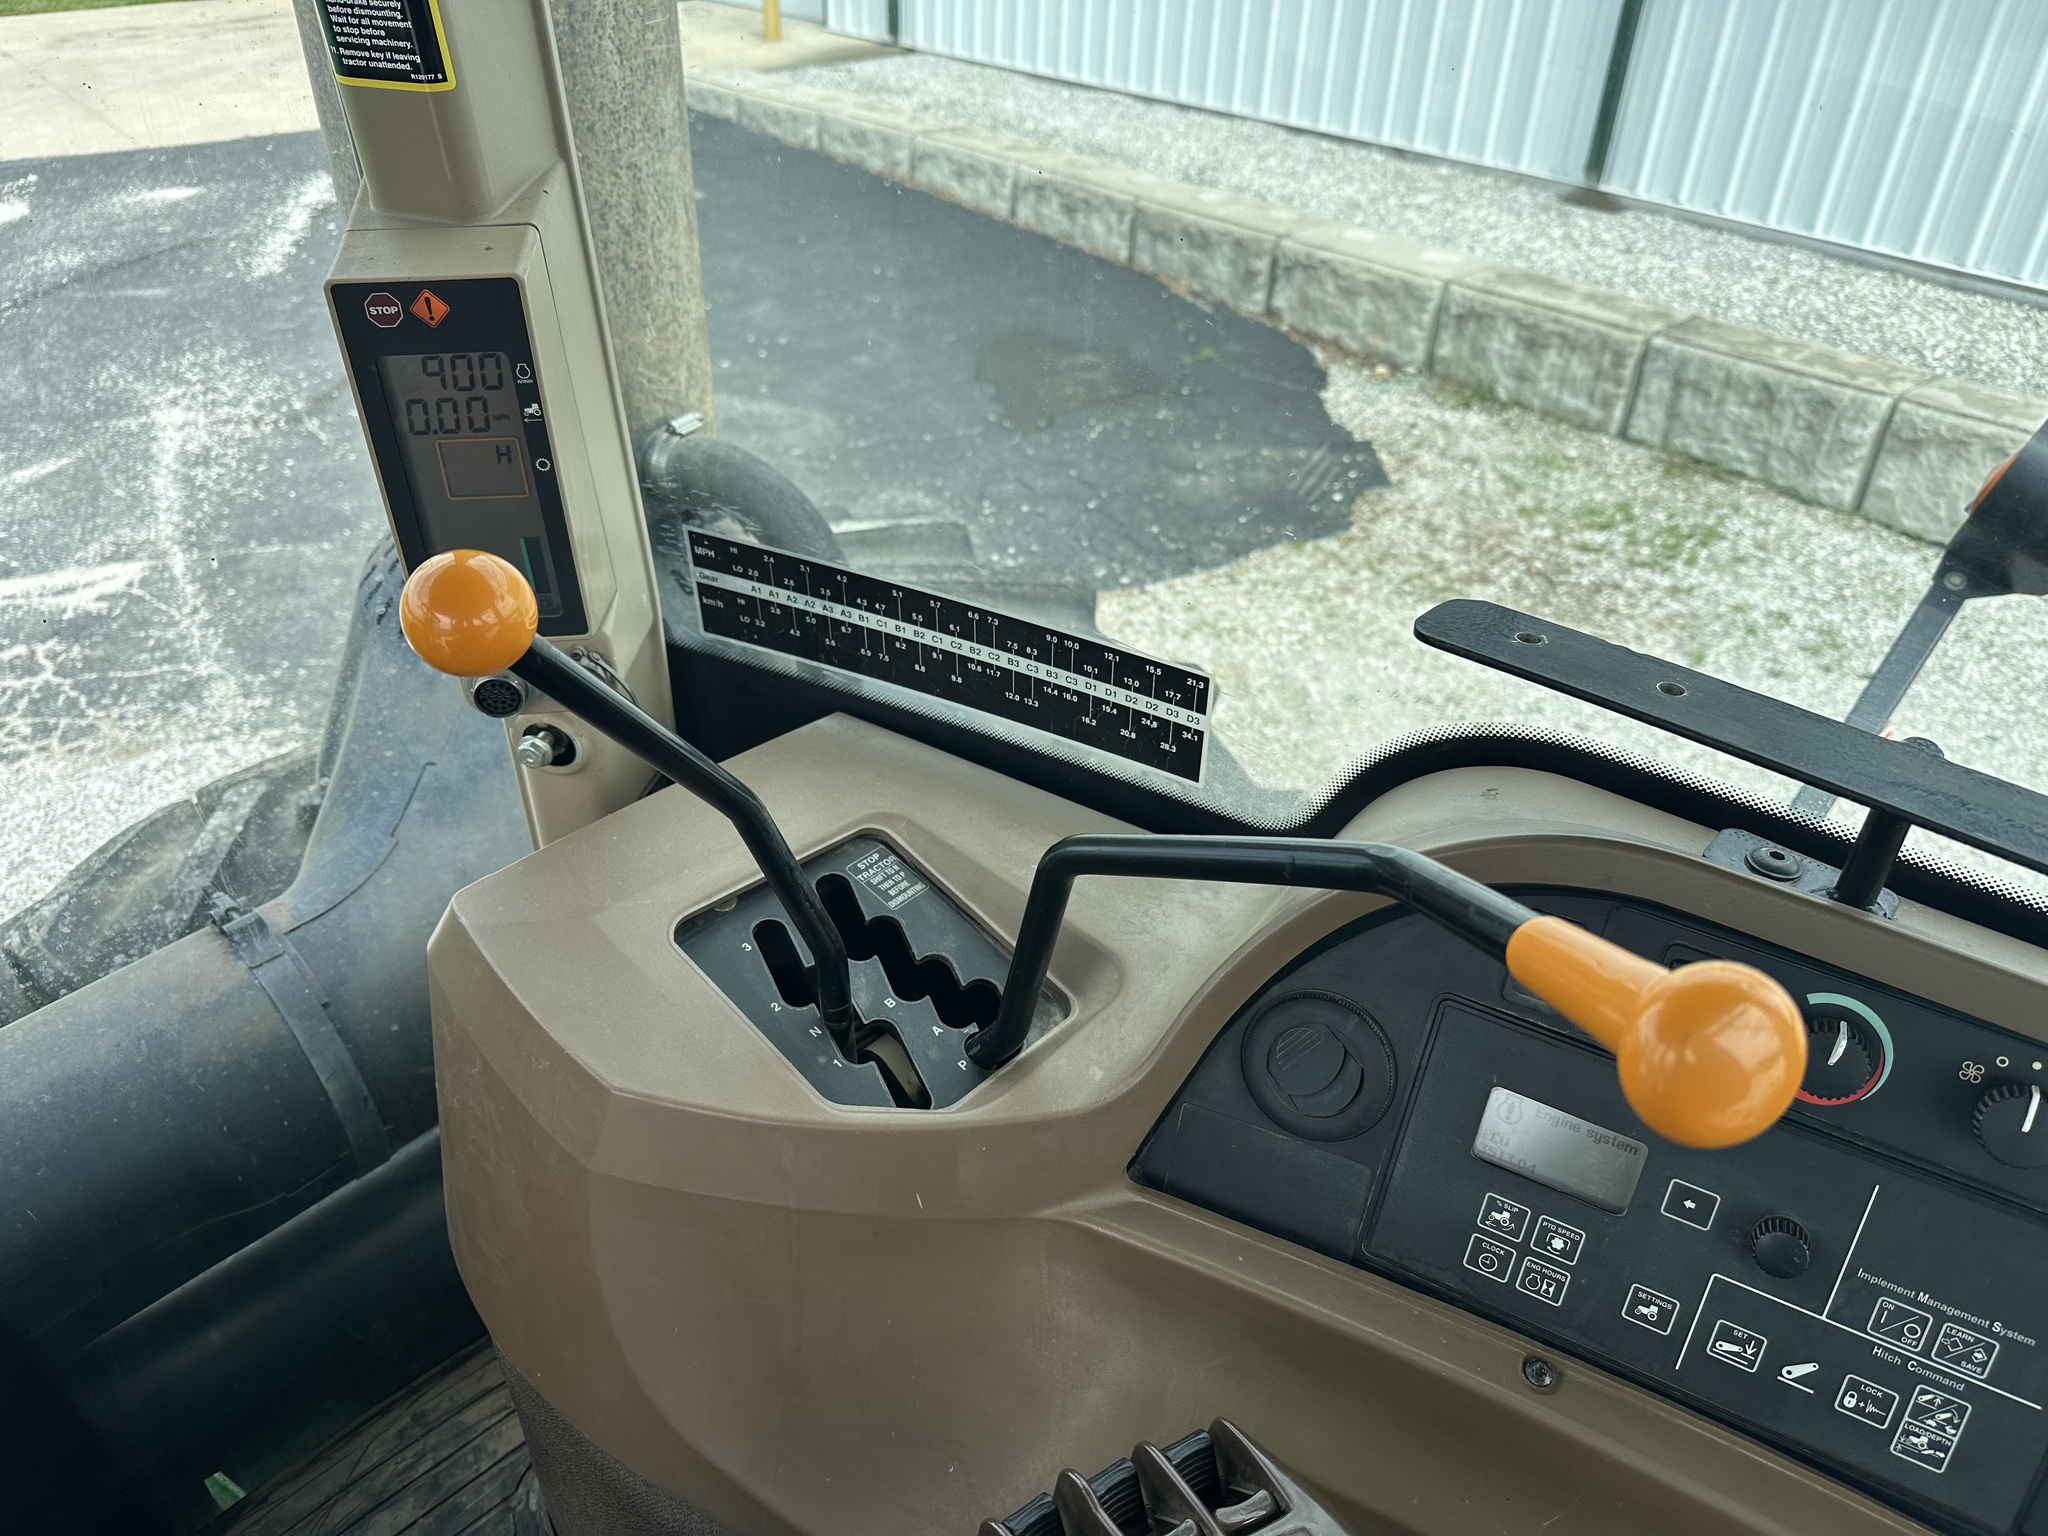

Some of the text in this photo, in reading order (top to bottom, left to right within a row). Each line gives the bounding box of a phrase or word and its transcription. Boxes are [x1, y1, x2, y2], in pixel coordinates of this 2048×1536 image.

[327, 5, 403, 19] before dismounting.
[330, 15, 347, 23] Wait
[348, 16, 359, 24] for
[372, 20, 412, 28] movement
[342, 26, 359, 35] stop
[360, 27, 385, 36] before
[336, 36, 413, 49] servicing machinery.
[340, 48, 370, 58] Remove
[371, 50, 384, 60] key
[385, 51, 392, 59] if
[392, 52, 420, 63] leaving
[342, 58, 413, 70] tractor unattended.
[369, 306, 399, 315] STOP
[421, 353, 504, 392] 900
[405, 396, 490, 436] 0.00
[495, 444, 512, 464] H
[694, 546, 715, 558] MPH
[764, 555, 774, 563] 2.4
[800, 564, 810, 573] 3.1
[836, 574, 848, 583] 4.2
[892, 590, 902, 598] 5.1
[930, 600, 941, 609] 5.7
[968, 611, 979, 620] 6.6
[987, 616, 998, 626] 7.3
[1046, 634, 1058, 643] 9.0
[1064, 640, 1080, 650] 10.0
[1104, 652, 1119, 662] 12.1
[1146, 665, 1162, 675] 15.5
[1187, 678, 1204, 688] 21.3
[732, 564, 744, 573] LO
[856, 598, 868, 606] 4.3
[875, 603, 886, 611] 4.7
[912, 613, 923, 622] 5.5
[949, 624, 960, 632] 6.1
[1006, 641, 1018, 650] 7.5
[1026, 646, 1038, 656] 8.3
[1083, 664, 1098, 674] 10.1
[1124, 677, 1140, 687] 13.0
[1165, 690, 1181, 700] 17.7
[699, 572, 1200, 725] Gear A1 A1 A2 A2 A3 A3 B1 C1 B1 B2 C1 C2 B2 C2 B3 C3 B3 C3 D1 D1 D2 D2 D3 D3
[702, 596, 724, 608] km/h
[841, 626, 852, 634] 6.7
[896, 641, 906, 650] 8.2
[932, 652, 942, 660] 9.1
[968, 663, 982, 672] 10.6
[986, 668, 1001, 678] 11.7
[1043, 686, 1058, 696] 14.4
[1063, 692, 1078, 702] 16.0
[1102, 704, 1117, 715] 19.4
[1141, 718, 1158, 728] 24.8
[1182, 731, 1198, 741] 34.1
[740, 615, 750, 623] LO
[755, 619, 765, 627] 3.2
[878, 653, 890, 662] 7.5
[1005, 691, 1020, 701] 12.0
[1024, 698, 1039, 707] 13.3
[1082, 716, 1097, 726] 16.2
[1120, 728, 1136, 739] 20.8
[1160, 742, 1176, 753] 28.3
[857, 853, 879, 870] STOP
[857, 855, 897, 881] TRACTOR
[870, 872, 887, 885] SHIFT
[878, 879, 895, 890] THEN
[892, 874, 902, 883] TO
[888, 880, 910, 896] BEFORE
[888, 882, 926, 908] DISMOUNTING
[741, 942, 753, 952] 3
[771, 1002, 782, 1013] 2
[884, 997, 897, 1009] B
[809, 1025, 823, 1039] N
[932, 1025, 944, 1036] A
[833, 1058, 843, 1068] 1
[957, 1060, 967, 1070] P
[1535, 1106, 1638, 1155] Engine system
[1504, 1204, 1519, 1212] SLIP
[1542, 1221, 1580, 1241] PTO SPEED
[1482, 1242, 1506, 1256] CLOCK
[1527, 1262, 1566, 1282] ENG HOURS
[1637, 1291, 1672, 1310] SETTINGS
[1857, 1268, 2036, 1347] Implement Management System
[1882, 1301, 1895, 1310] ON
[1732, 1329, 1749, 1340] SET
[1901, 1336, 1918, 1347] OFF
[1946, 1327, 1975, 1343] LEARN
[1872, 1345, 1965, 1391] Hitch Command
[1961, 1360, 1983, 1374] SAVE
[1860, 1384, 1883, 1398] LOCK
[1904, 1422, 1951, 1446] LOAD/DEPTH
